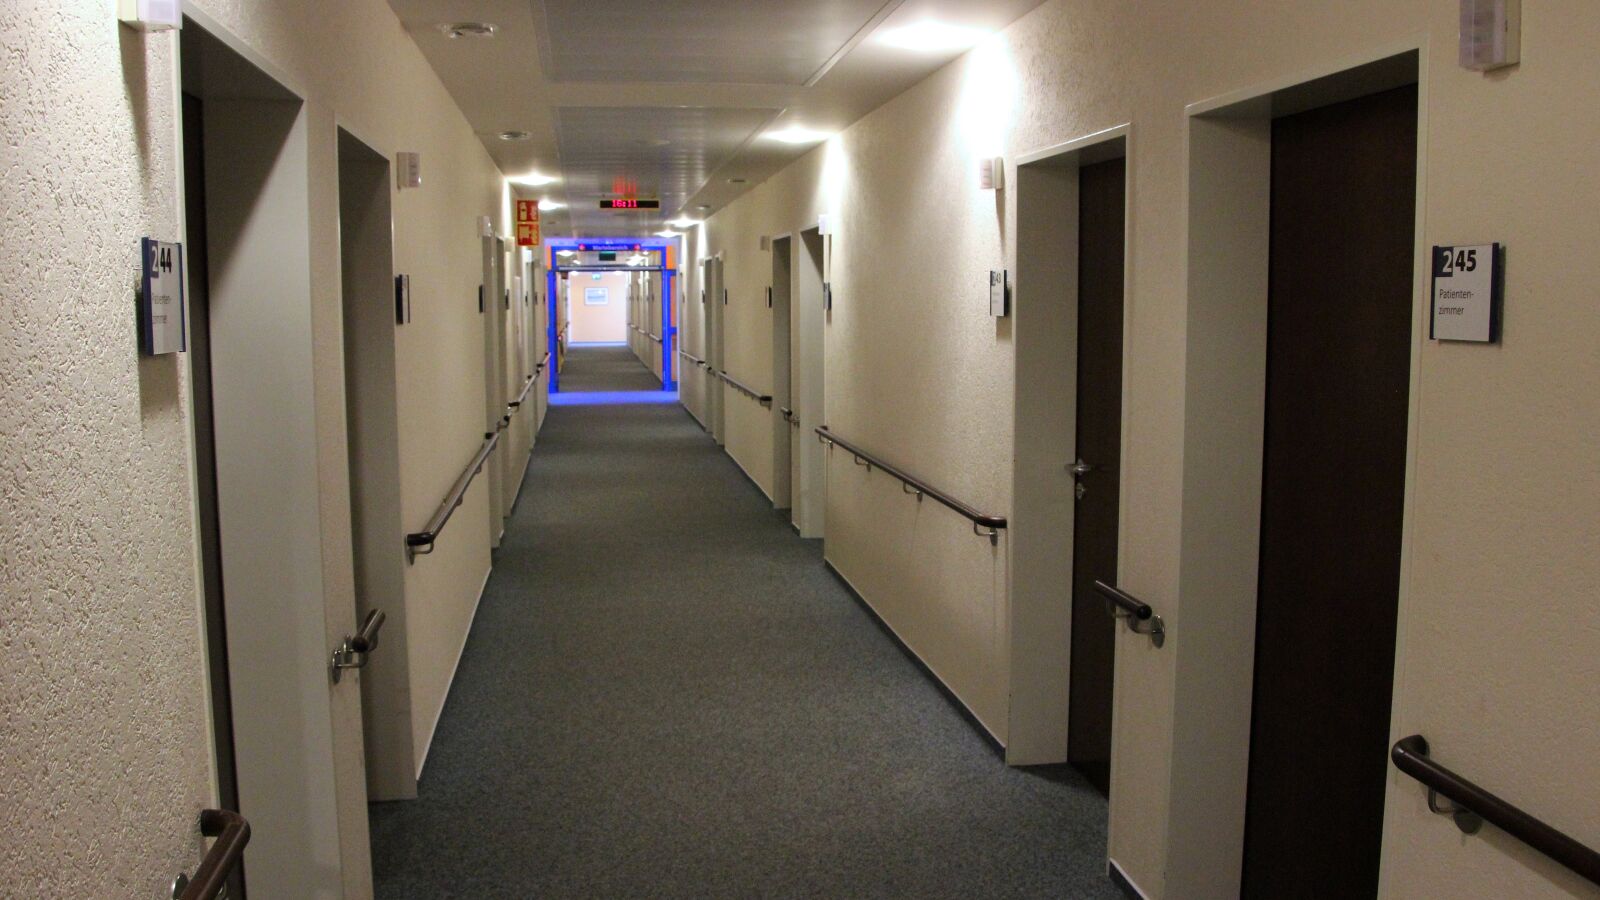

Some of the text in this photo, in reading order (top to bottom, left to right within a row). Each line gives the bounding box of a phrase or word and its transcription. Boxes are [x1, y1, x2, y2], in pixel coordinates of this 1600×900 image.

[613, 200, 638, 208] 16:11
[151, 245, 172, 273] 244
[1442, 249, 1477, 272] 245
[1439, 289, 1475, 300] Patienten-
[1438, 305, 1465, 316] zimmer
